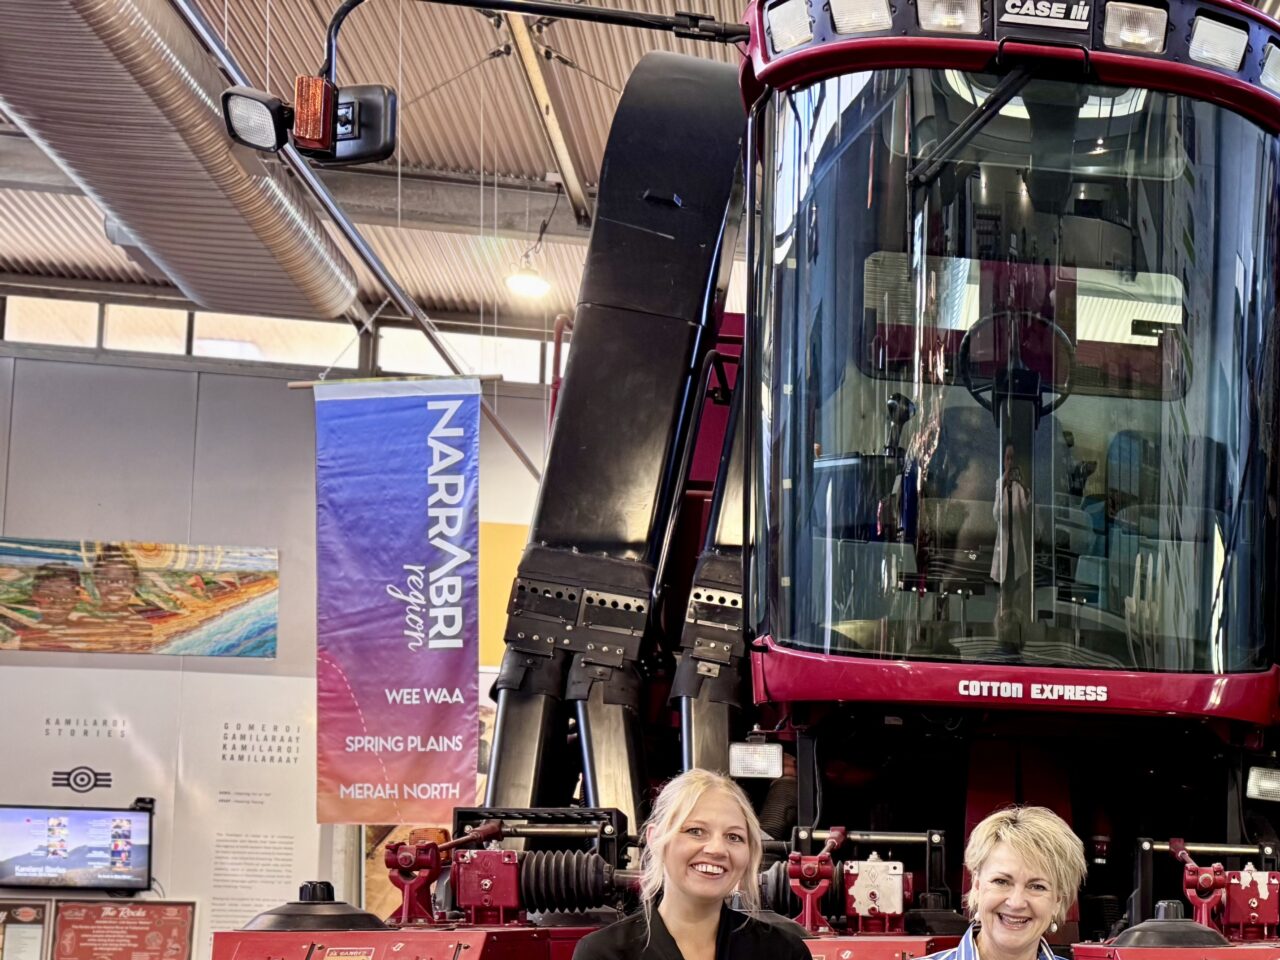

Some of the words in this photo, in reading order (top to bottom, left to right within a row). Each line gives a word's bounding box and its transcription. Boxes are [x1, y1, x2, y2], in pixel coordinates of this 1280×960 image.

[1005, 0, 1066, 18] CASE
[427, 400, 471, 649] NARRABRI
[386, 564, 426, 653] region
[385, 688, 421, 704] WEE
[423, 687, 465, 704] WAA
[958, 680, 1023, 698] COTTON
[1030, 683, 1108, 701] EXPRESS
[45, 718, 127, 728] KAMILAROI
[224, 722, 301, 734] GOMEROI
[44, 729, 126, 738] STORIES
[222, 743, 300, 754] KAMILAROI
[345, 736, 404, 752] SPRING
[407, 735, 463, 752] PLAINS
[221, 754, 299, 764] KAMILARAAY
[339, 783, 399, 799] MERAH
[403, 782, 460, 799] NORTH
